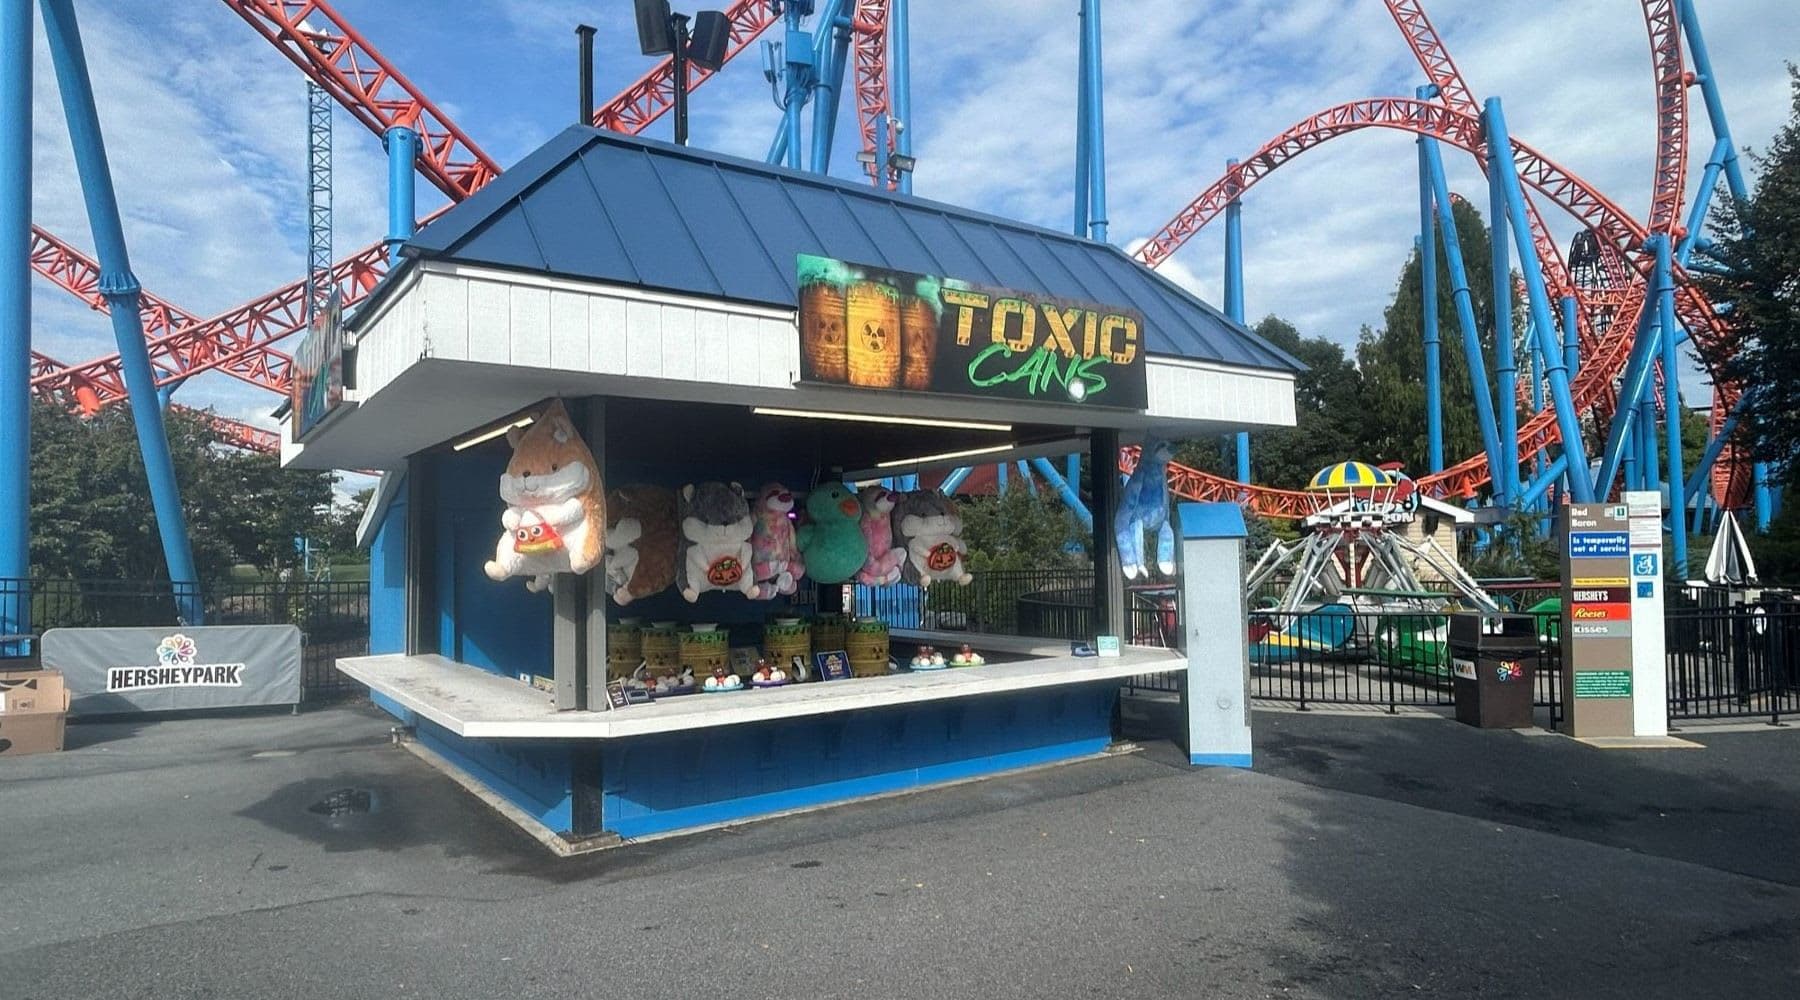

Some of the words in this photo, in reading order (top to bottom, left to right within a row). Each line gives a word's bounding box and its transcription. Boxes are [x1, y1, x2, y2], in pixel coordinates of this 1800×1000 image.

[941, 287, 1138, 365] TOXIC
[968, 343, 1112, 396] CANS
[1571, 507, 1588, 516] Red
[1571, 519, 1597, 527] Baron
[1583, 536, 1627, 545] temporarily
[110, 665, 239, 689] HERSHEYPARK
